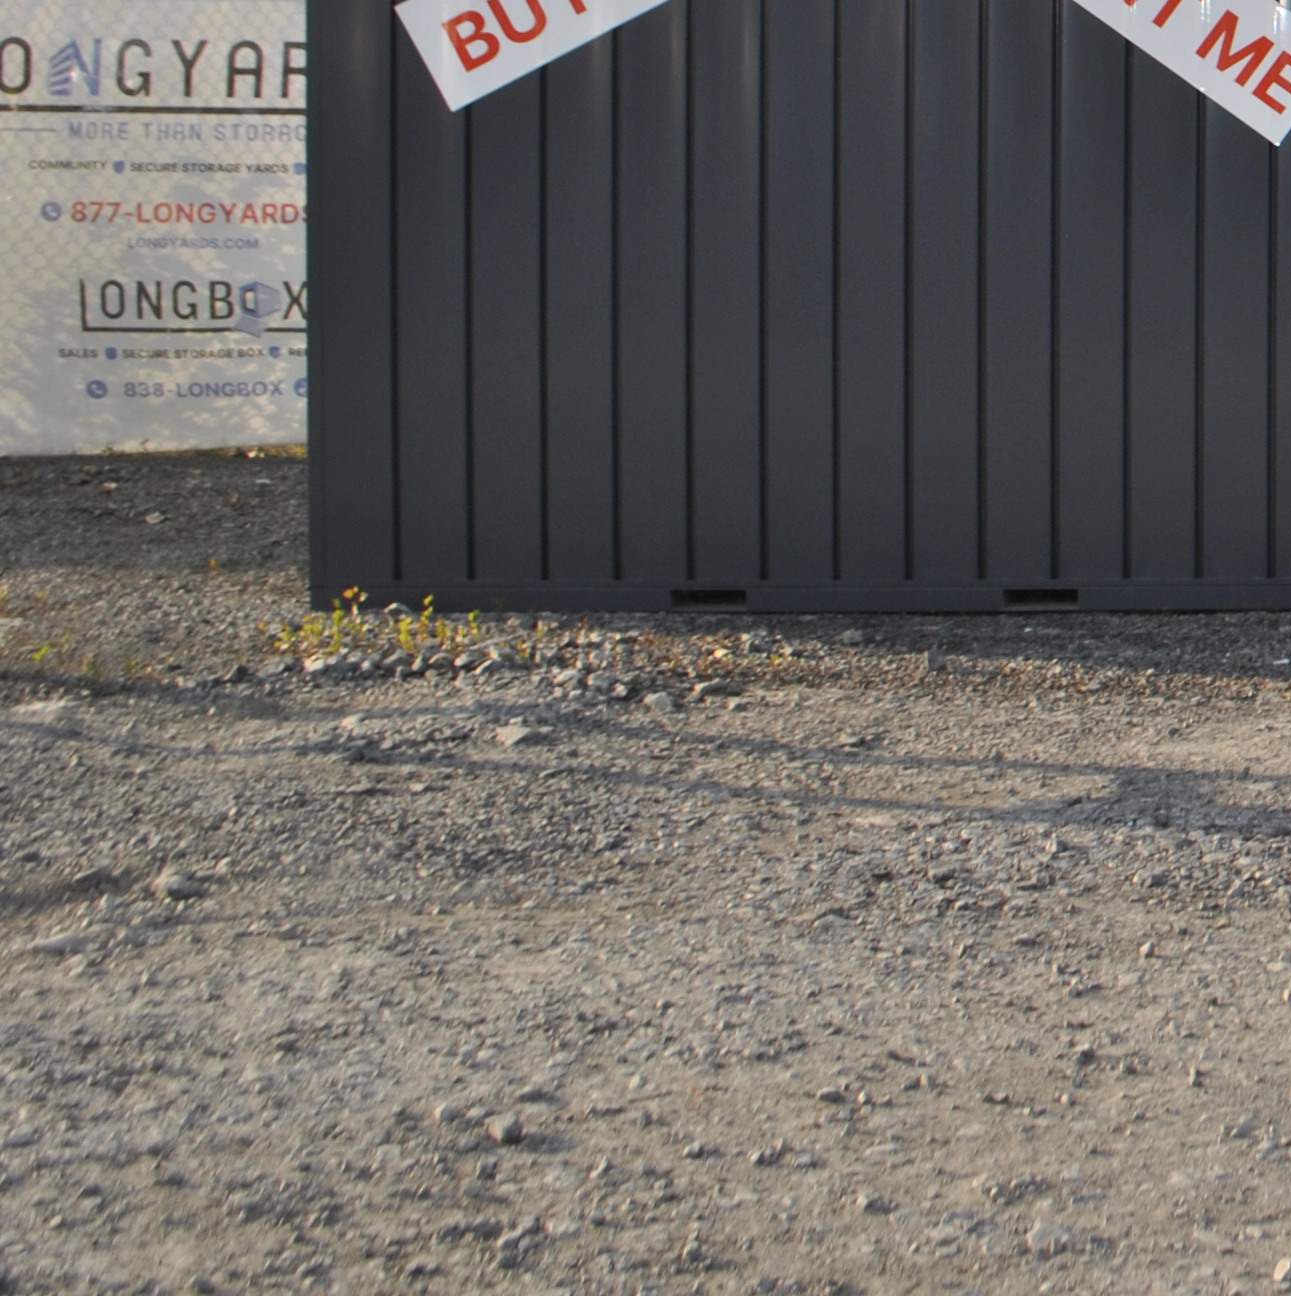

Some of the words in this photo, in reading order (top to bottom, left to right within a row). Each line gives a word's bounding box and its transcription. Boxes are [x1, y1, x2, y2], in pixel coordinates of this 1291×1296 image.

[68, 122, 129, 140] MORE
[143, 123, 201, 141] THAN
[28, 159, 107, 171] COMMUNITY
[130, 162, 178, 173] SECURE
[181, 162, 242, 174] STORAGE
[246, 163, 290, 175] YARDS
[127, 237, 260, 250] LONGYARDS.COM
[58, 348, 99, 359] SALES
[122, 348, 171, 359] SECURE
[174, 348, 234, 359] STORAGE
[237, 347, 265, 358] BOX
[124, 382, 284, 398] 838-LONGBOX
